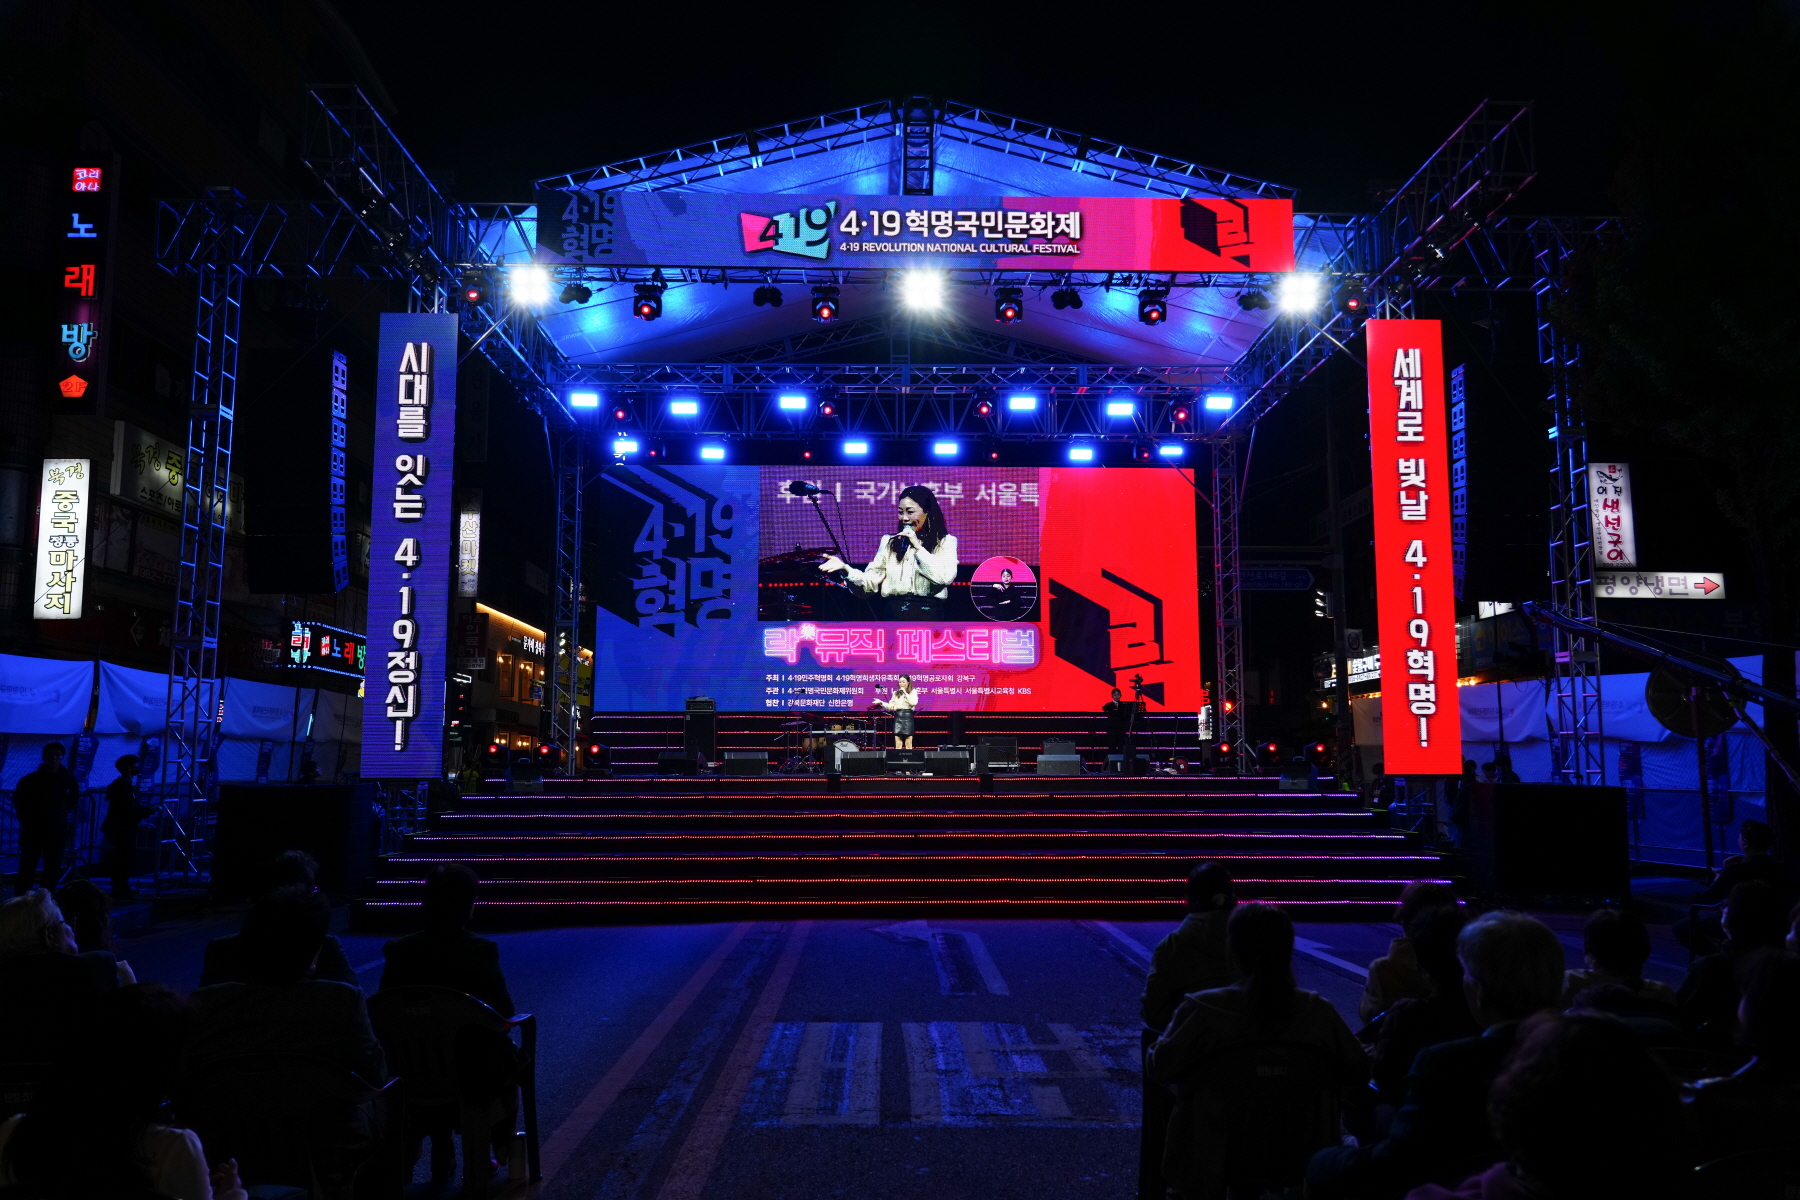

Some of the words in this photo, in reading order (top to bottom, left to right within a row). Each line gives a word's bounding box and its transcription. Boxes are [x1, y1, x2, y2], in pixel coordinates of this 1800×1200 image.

[863, 242, 924, 252] REVOLUTION
[926, 243, 977, 253] NATIONAL
[979, 243, 1031, 253] CULTURAL
[1033, 244, 1080, 254] FESTIVAL
[61, 213, 97, 361] 노래방
[63, 382, 87, 392] 2F
[397, 342, 430, 439] 시대를
[1393, 348, 1425, 442] 세계로
[393, 454, 426, 519] 잇는
[1397, 458, 1428, 521] 빛날
[815, 629, 885, 663] 뮤직
[896, 629, 1035, 664] 페스티벌
[1017, 687, 1032, 695] KBS
